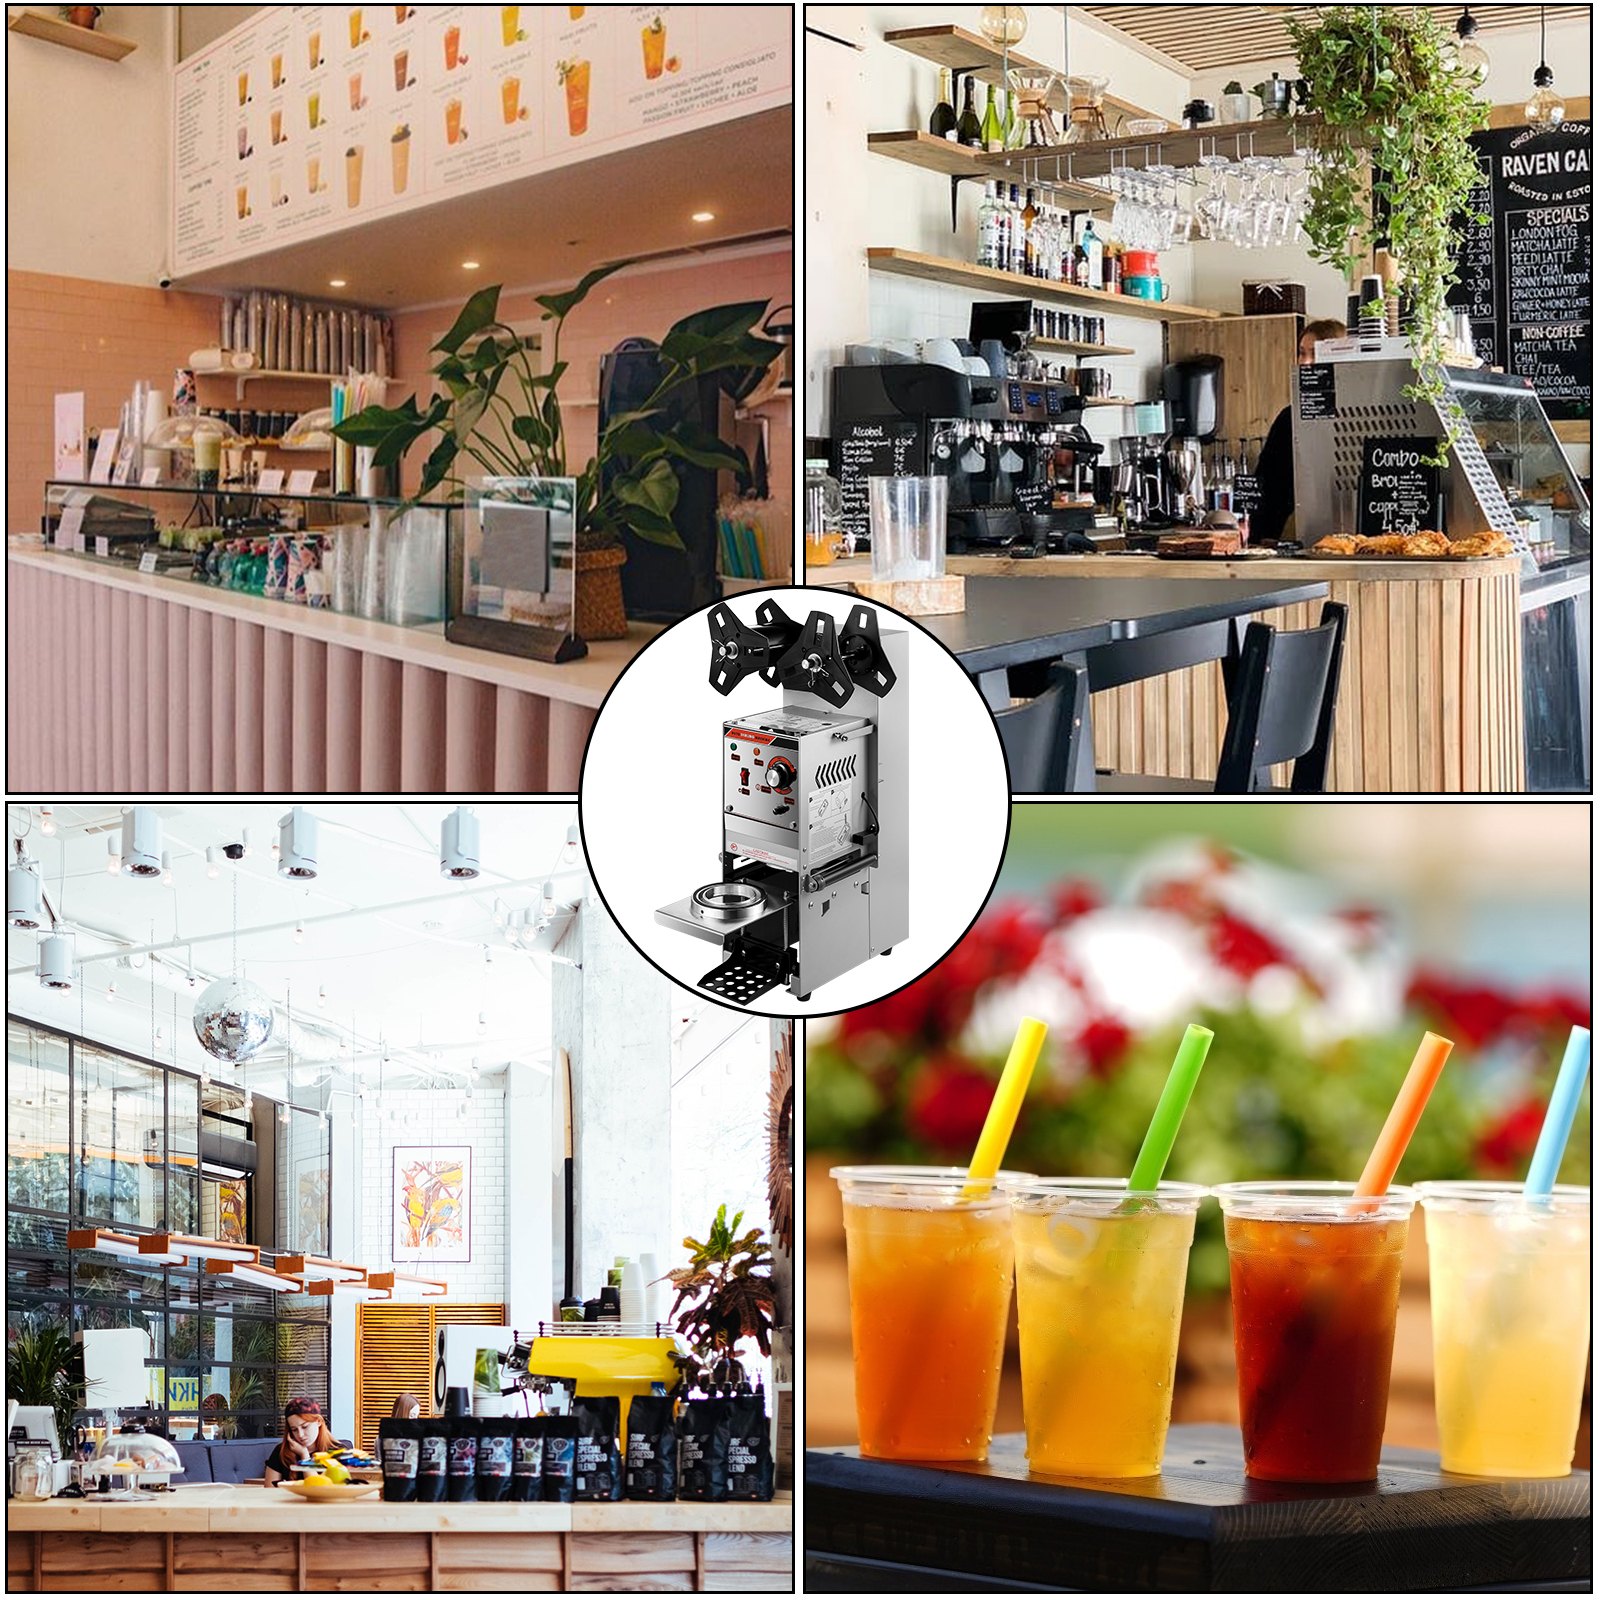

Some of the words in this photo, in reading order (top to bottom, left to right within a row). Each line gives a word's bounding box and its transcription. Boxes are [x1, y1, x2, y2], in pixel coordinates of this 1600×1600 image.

[732, 76, 759, 90] PEACH
[1501, 151, 1560, 178] RAVEN
[1564, 148, 1590, 172] CA
[1507, 181, 1548, 201] ROASTED
[1551, 192, 1563, 201] IN
[1526, 205, 1590, 226] SPECIALS
[1511, 226, 1554, 240] LONDON
[1555, 223, 1578, 238] FOG
[1511, 239, 1551, 252] MATCHA
[1542, 250, 1575, 264] LATTE
[1474, 291, 1482, 303] 6
[1513, 340, 1552, 352] MATCHA
[1554, 338, 1577, 352] TEA
[1372, 448, 1419, 467] Combo
